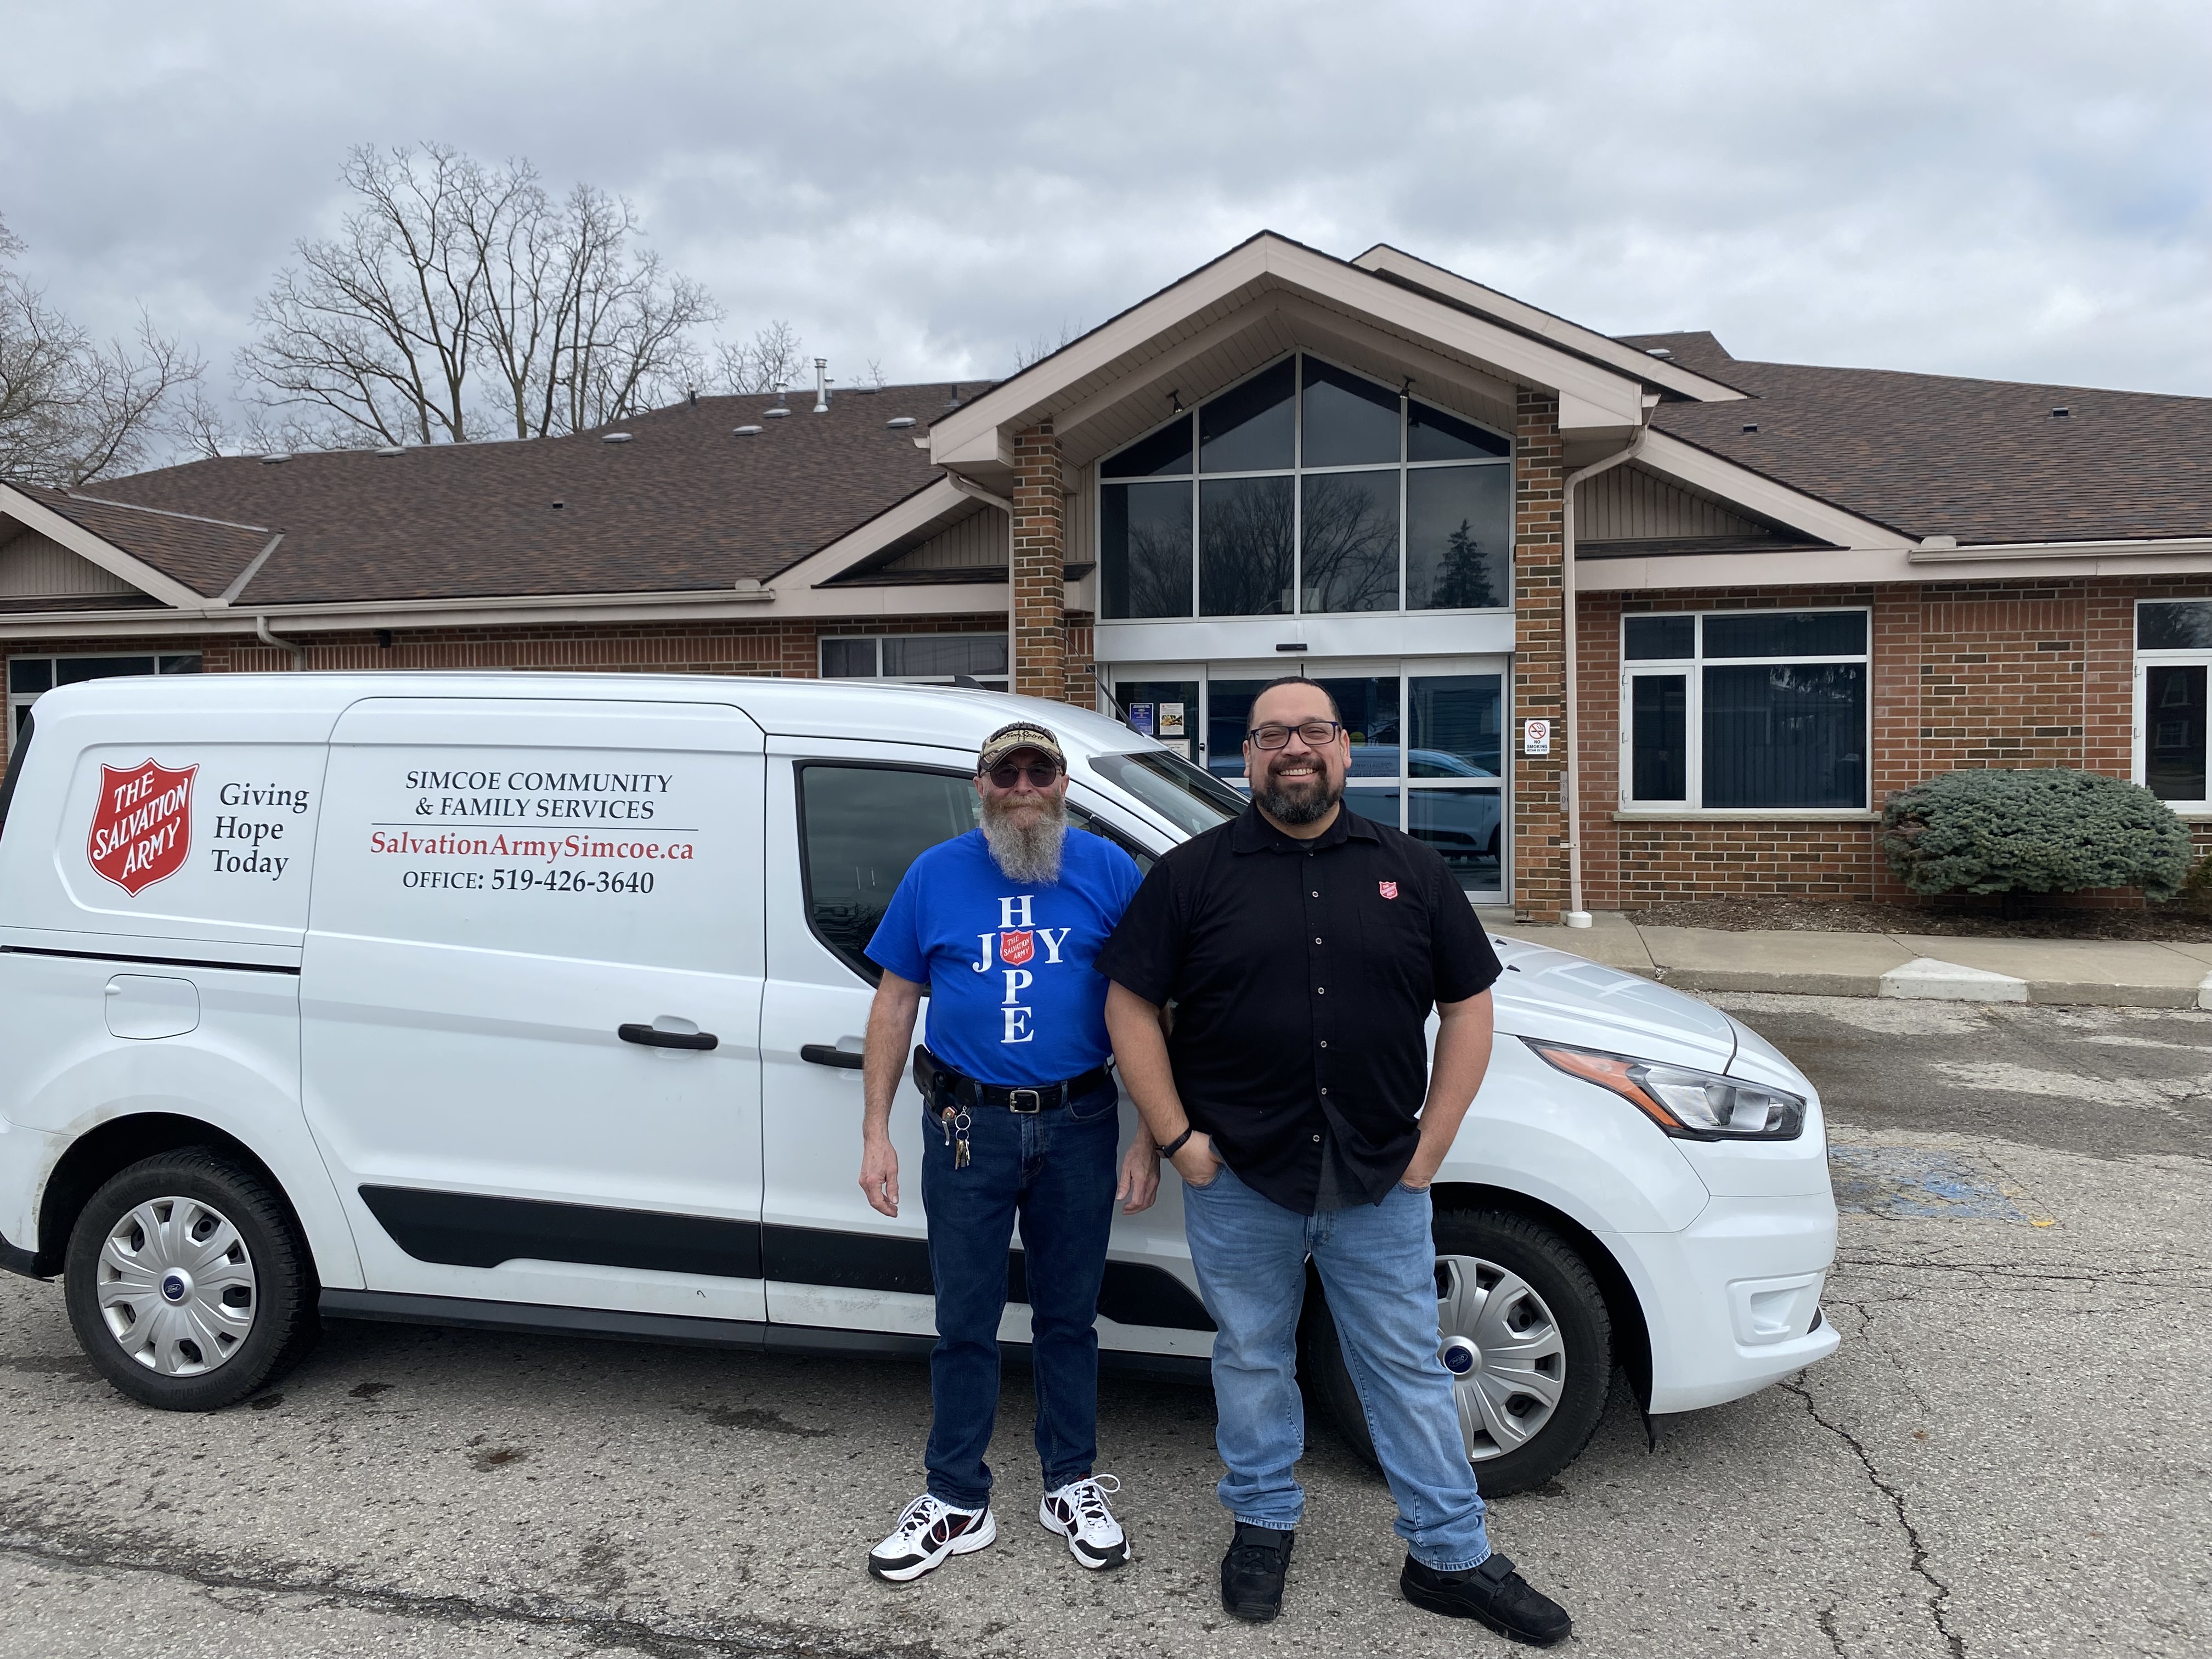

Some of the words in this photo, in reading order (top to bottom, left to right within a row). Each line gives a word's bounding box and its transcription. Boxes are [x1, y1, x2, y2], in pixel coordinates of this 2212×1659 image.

[1020, 731, 1044, 740] Spirit
[114, 770, 155, 814] THE
[405, 771, 501, 791] SIMCOE
[507, 772, 673, 793] COMMUNITY
[220, 782, 309, 814] Giving
[415, 800, 433, 816] &
[439, 797, 531, 817] FAMILY
[536, 799, 654, 819] SERVICES
[93, 777, 188, 861] SALVATION
[213, 816, 284, 847] Hope
[121, 816, 181, 880] ARMY
[370, 832, 693, 864] SalvationArmySimcoe.ca
[211, 850, 289, 881] Today
[403, 871, 484, 890] OFFICE:
[491, 869, 654, 894] 519-426-3640
[1003, 936, 1030, 956] SALVATION
[1007, 935, 1019, 946] THE
[1013, 946, 1030, 961] ARMY
